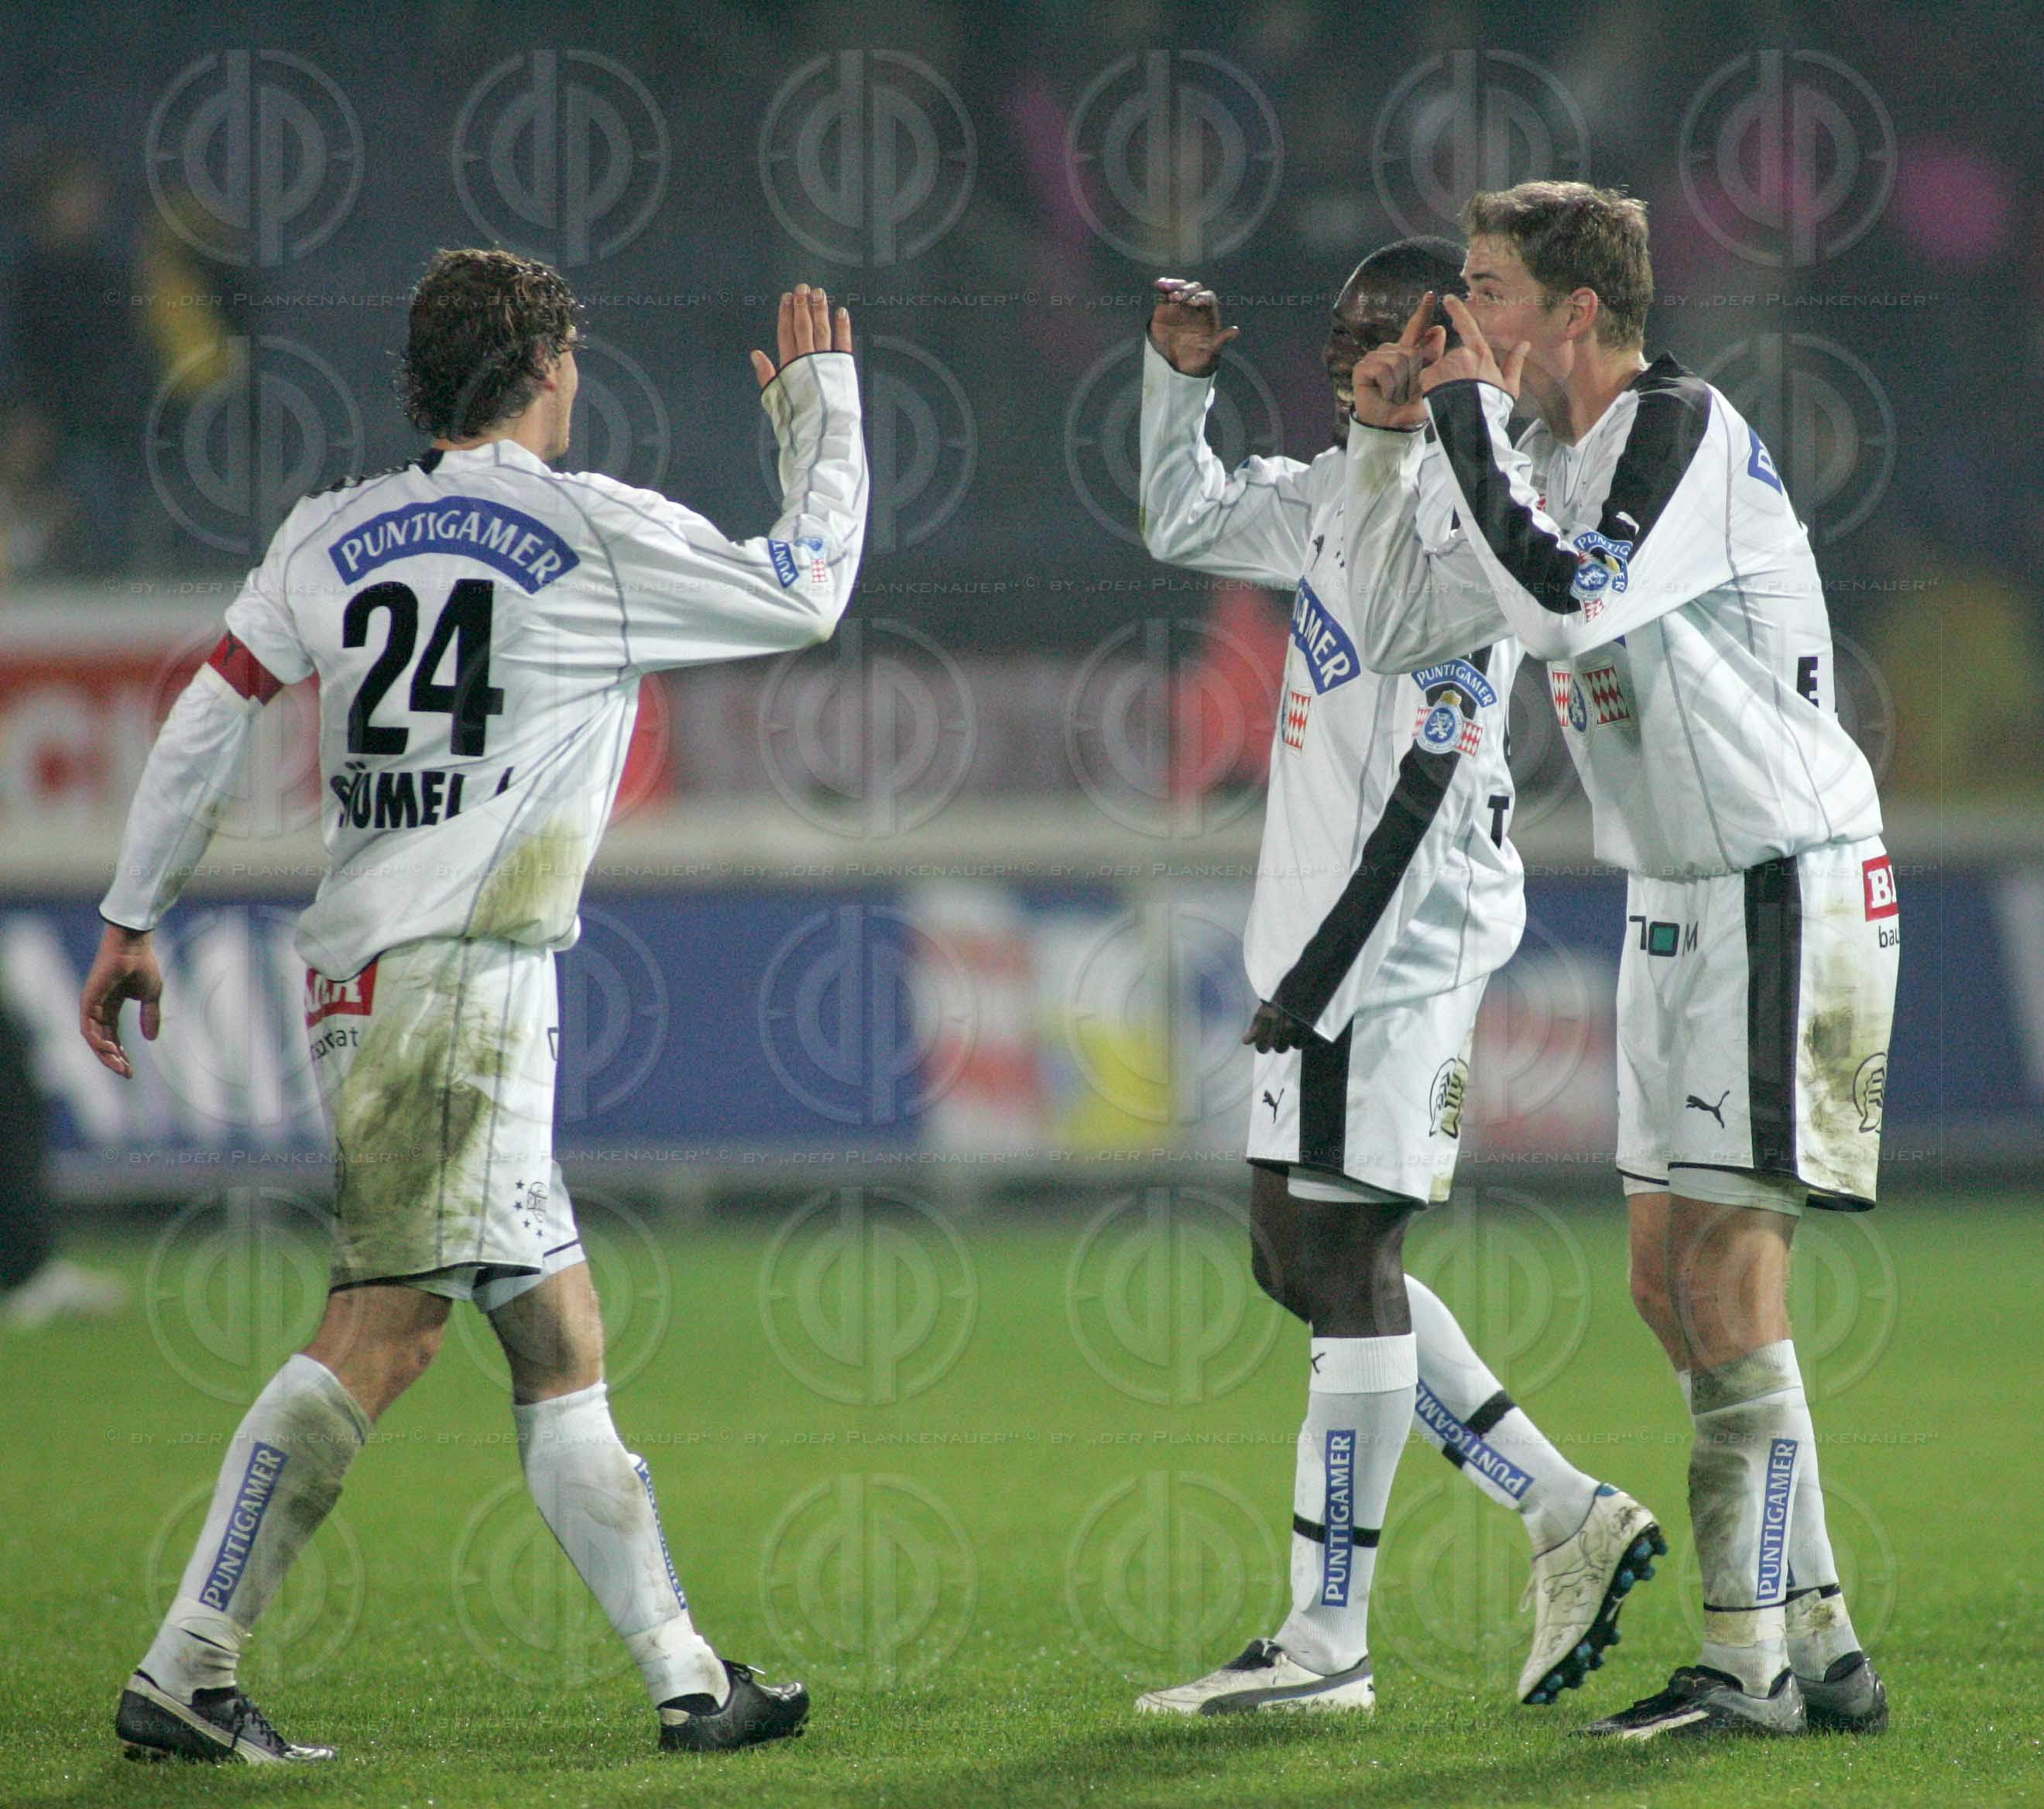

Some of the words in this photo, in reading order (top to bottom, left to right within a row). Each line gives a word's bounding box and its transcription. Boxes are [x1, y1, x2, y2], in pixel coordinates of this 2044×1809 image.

[341, 510, 562, 582] PUNTIGAMER
[342, 578, 504, 757] 24
[1417, 664, 1494, 706] PUNTIGAMER
[1797, 656, 1819, 708] E
[1487, 795, 1510, 849] T
[204, 1449, 282, 1609] PUNTIGAMER
[1325, 1435, 1352, 1601] PUNTIGAMER
[1758, 1442, 1795, 1600] PUNTIGAMER
